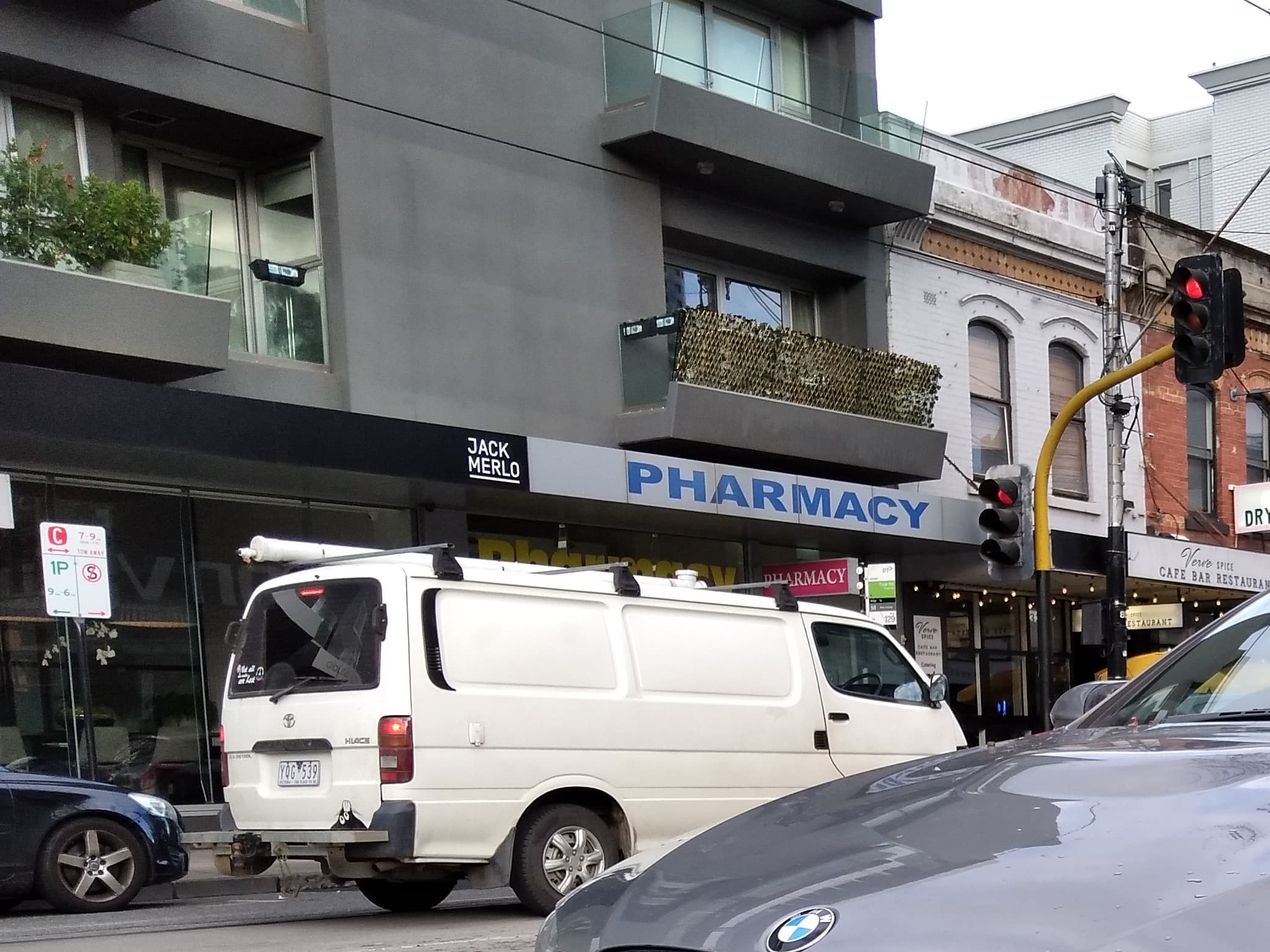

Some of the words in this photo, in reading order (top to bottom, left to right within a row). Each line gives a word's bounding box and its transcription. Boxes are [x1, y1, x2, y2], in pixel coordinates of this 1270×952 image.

[467, 436, 510, 459] JACK
[468, 455, 520, 478] MERLO
[627, 461, 929, 529] PHARMACY
[50, 560, 69, 575] 1P
[1180, 547, 1213, 569] Verve
[1216, 561, 1234, 572] SPICE
[764, 567, 847, 587] PHARMACY
[1159, 566, 1186, 580] CAFE
[1192, 570, 1211, 583] BAR
[1127, 618, 1173, 628] ESTAURANT
[280, 764, 296, 780] YQG
[301, 764, 318, 780] 539
